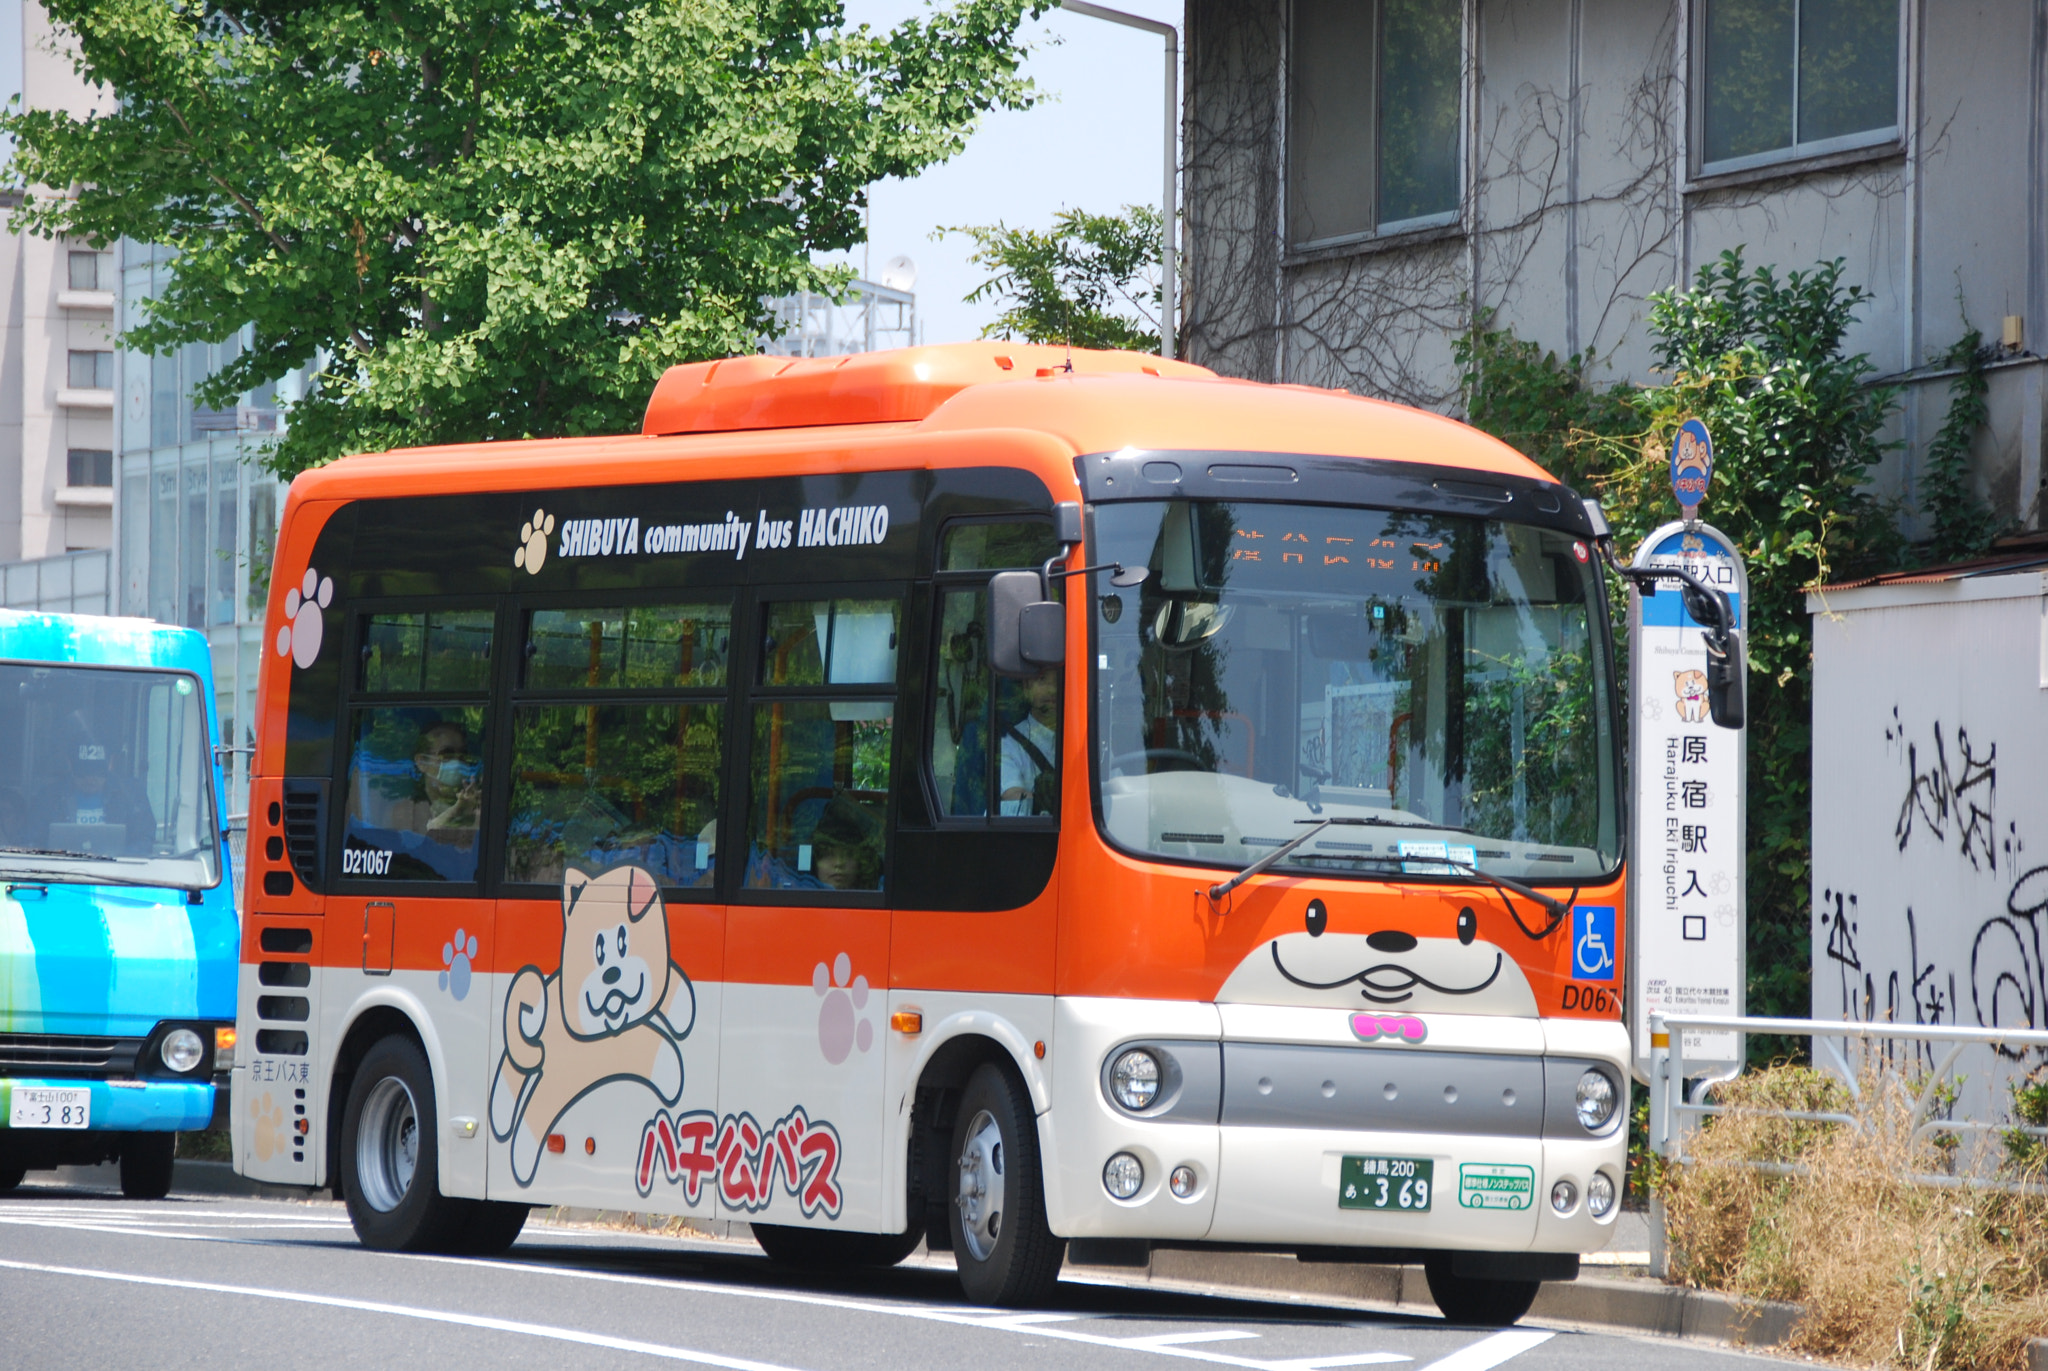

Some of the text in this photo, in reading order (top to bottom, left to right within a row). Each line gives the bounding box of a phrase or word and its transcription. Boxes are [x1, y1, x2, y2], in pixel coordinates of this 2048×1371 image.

[559, 505, 889, 560] SHIBUYA community bus HACHIKO
[1663, 737, 1679, 911] Harajuku Eki Iriguchi
[1681, 735, 1708, 941] 原宿駅入口
[343, 849, 393, 875] D21067
[1562, 985, 1618, 1013] D067
[251, 1060, 310, 1083] 京王バス東
[635, 1105, 843, 1221] ハチ公バス
